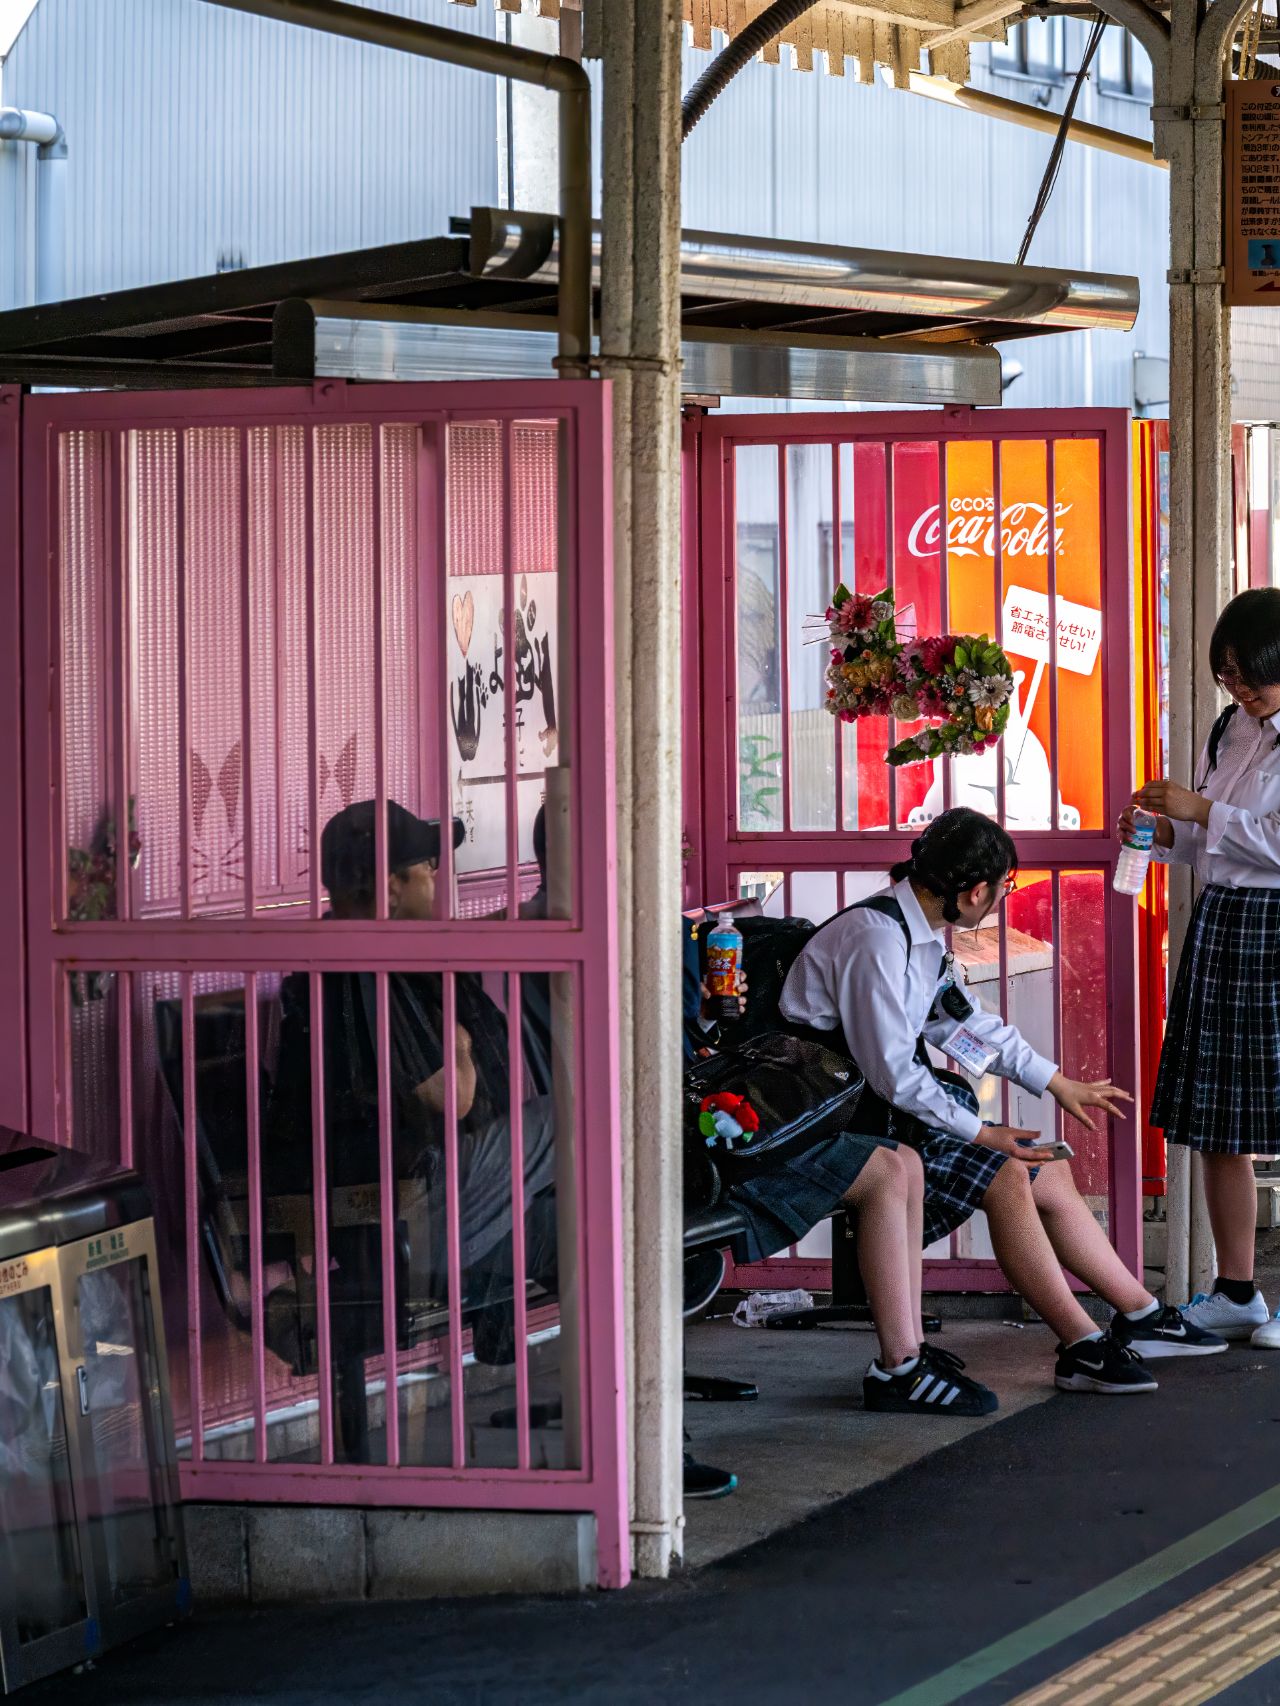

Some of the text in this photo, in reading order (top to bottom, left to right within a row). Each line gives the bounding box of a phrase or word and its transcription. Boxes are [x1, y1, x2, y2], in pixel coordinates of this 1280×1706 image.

[1011, 621, 1086, 653] 節電させい!
